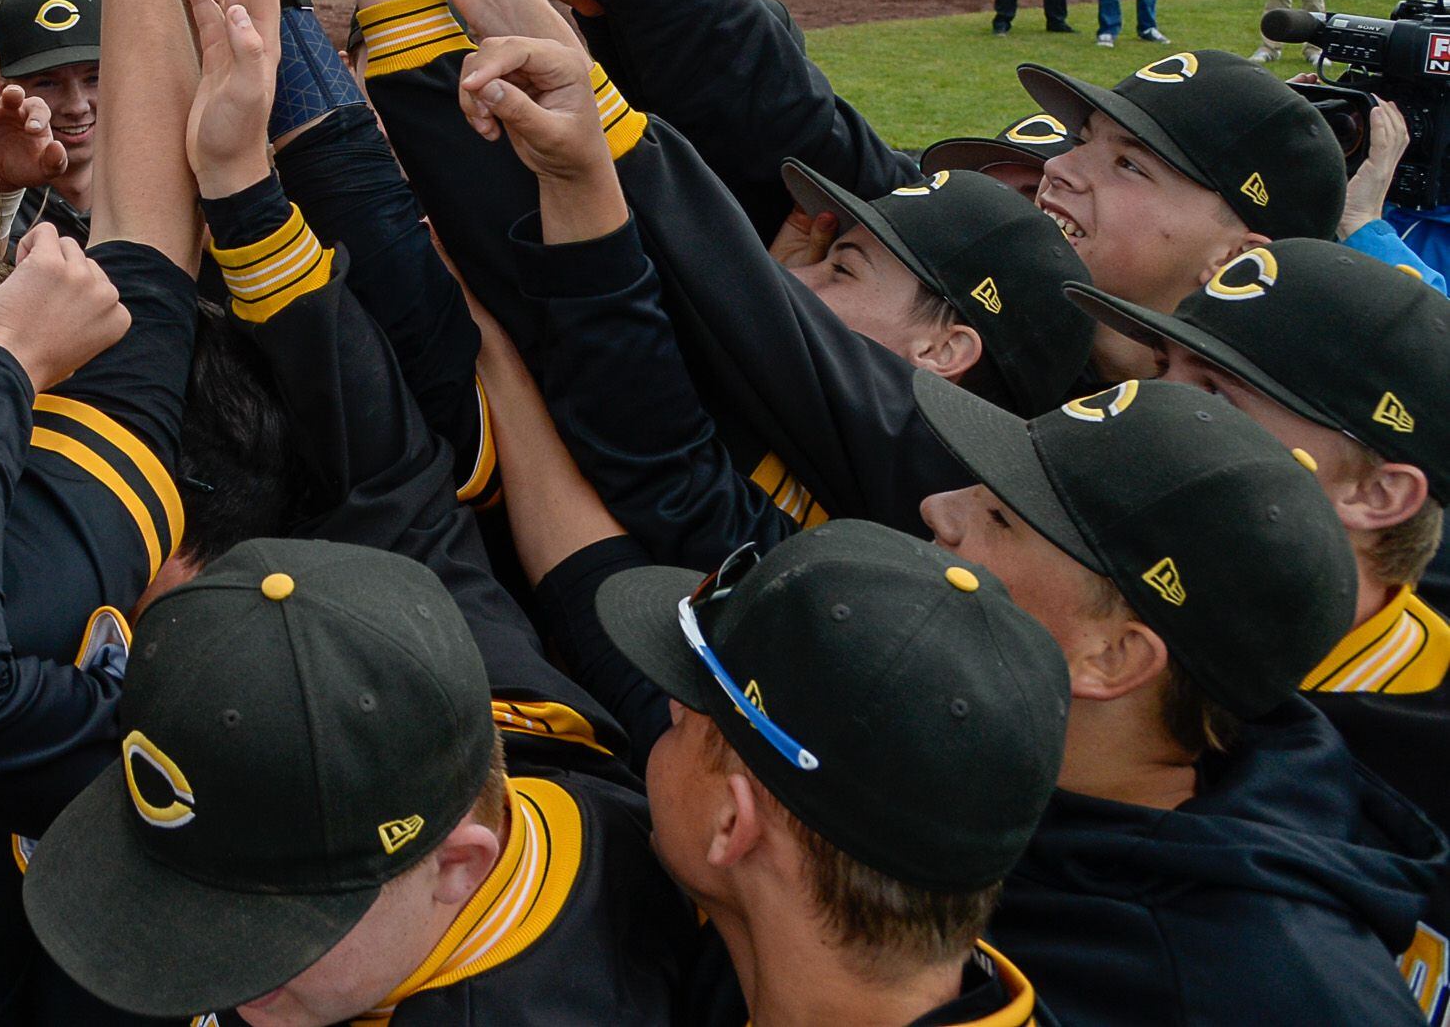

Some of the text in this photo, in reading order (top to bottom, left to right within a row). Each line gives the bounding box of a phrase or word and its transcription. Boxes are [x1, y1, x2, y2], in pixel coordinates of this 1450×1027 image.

[1357, 23, 1382, 32] SONY
[1135, 52, 1198, 83] C
[1005, 114, 1068, 145] C
[1205, 247, 1278, 301] C
[1061, 379, 1139, 422] C
[122, 730, 196, 828] C
